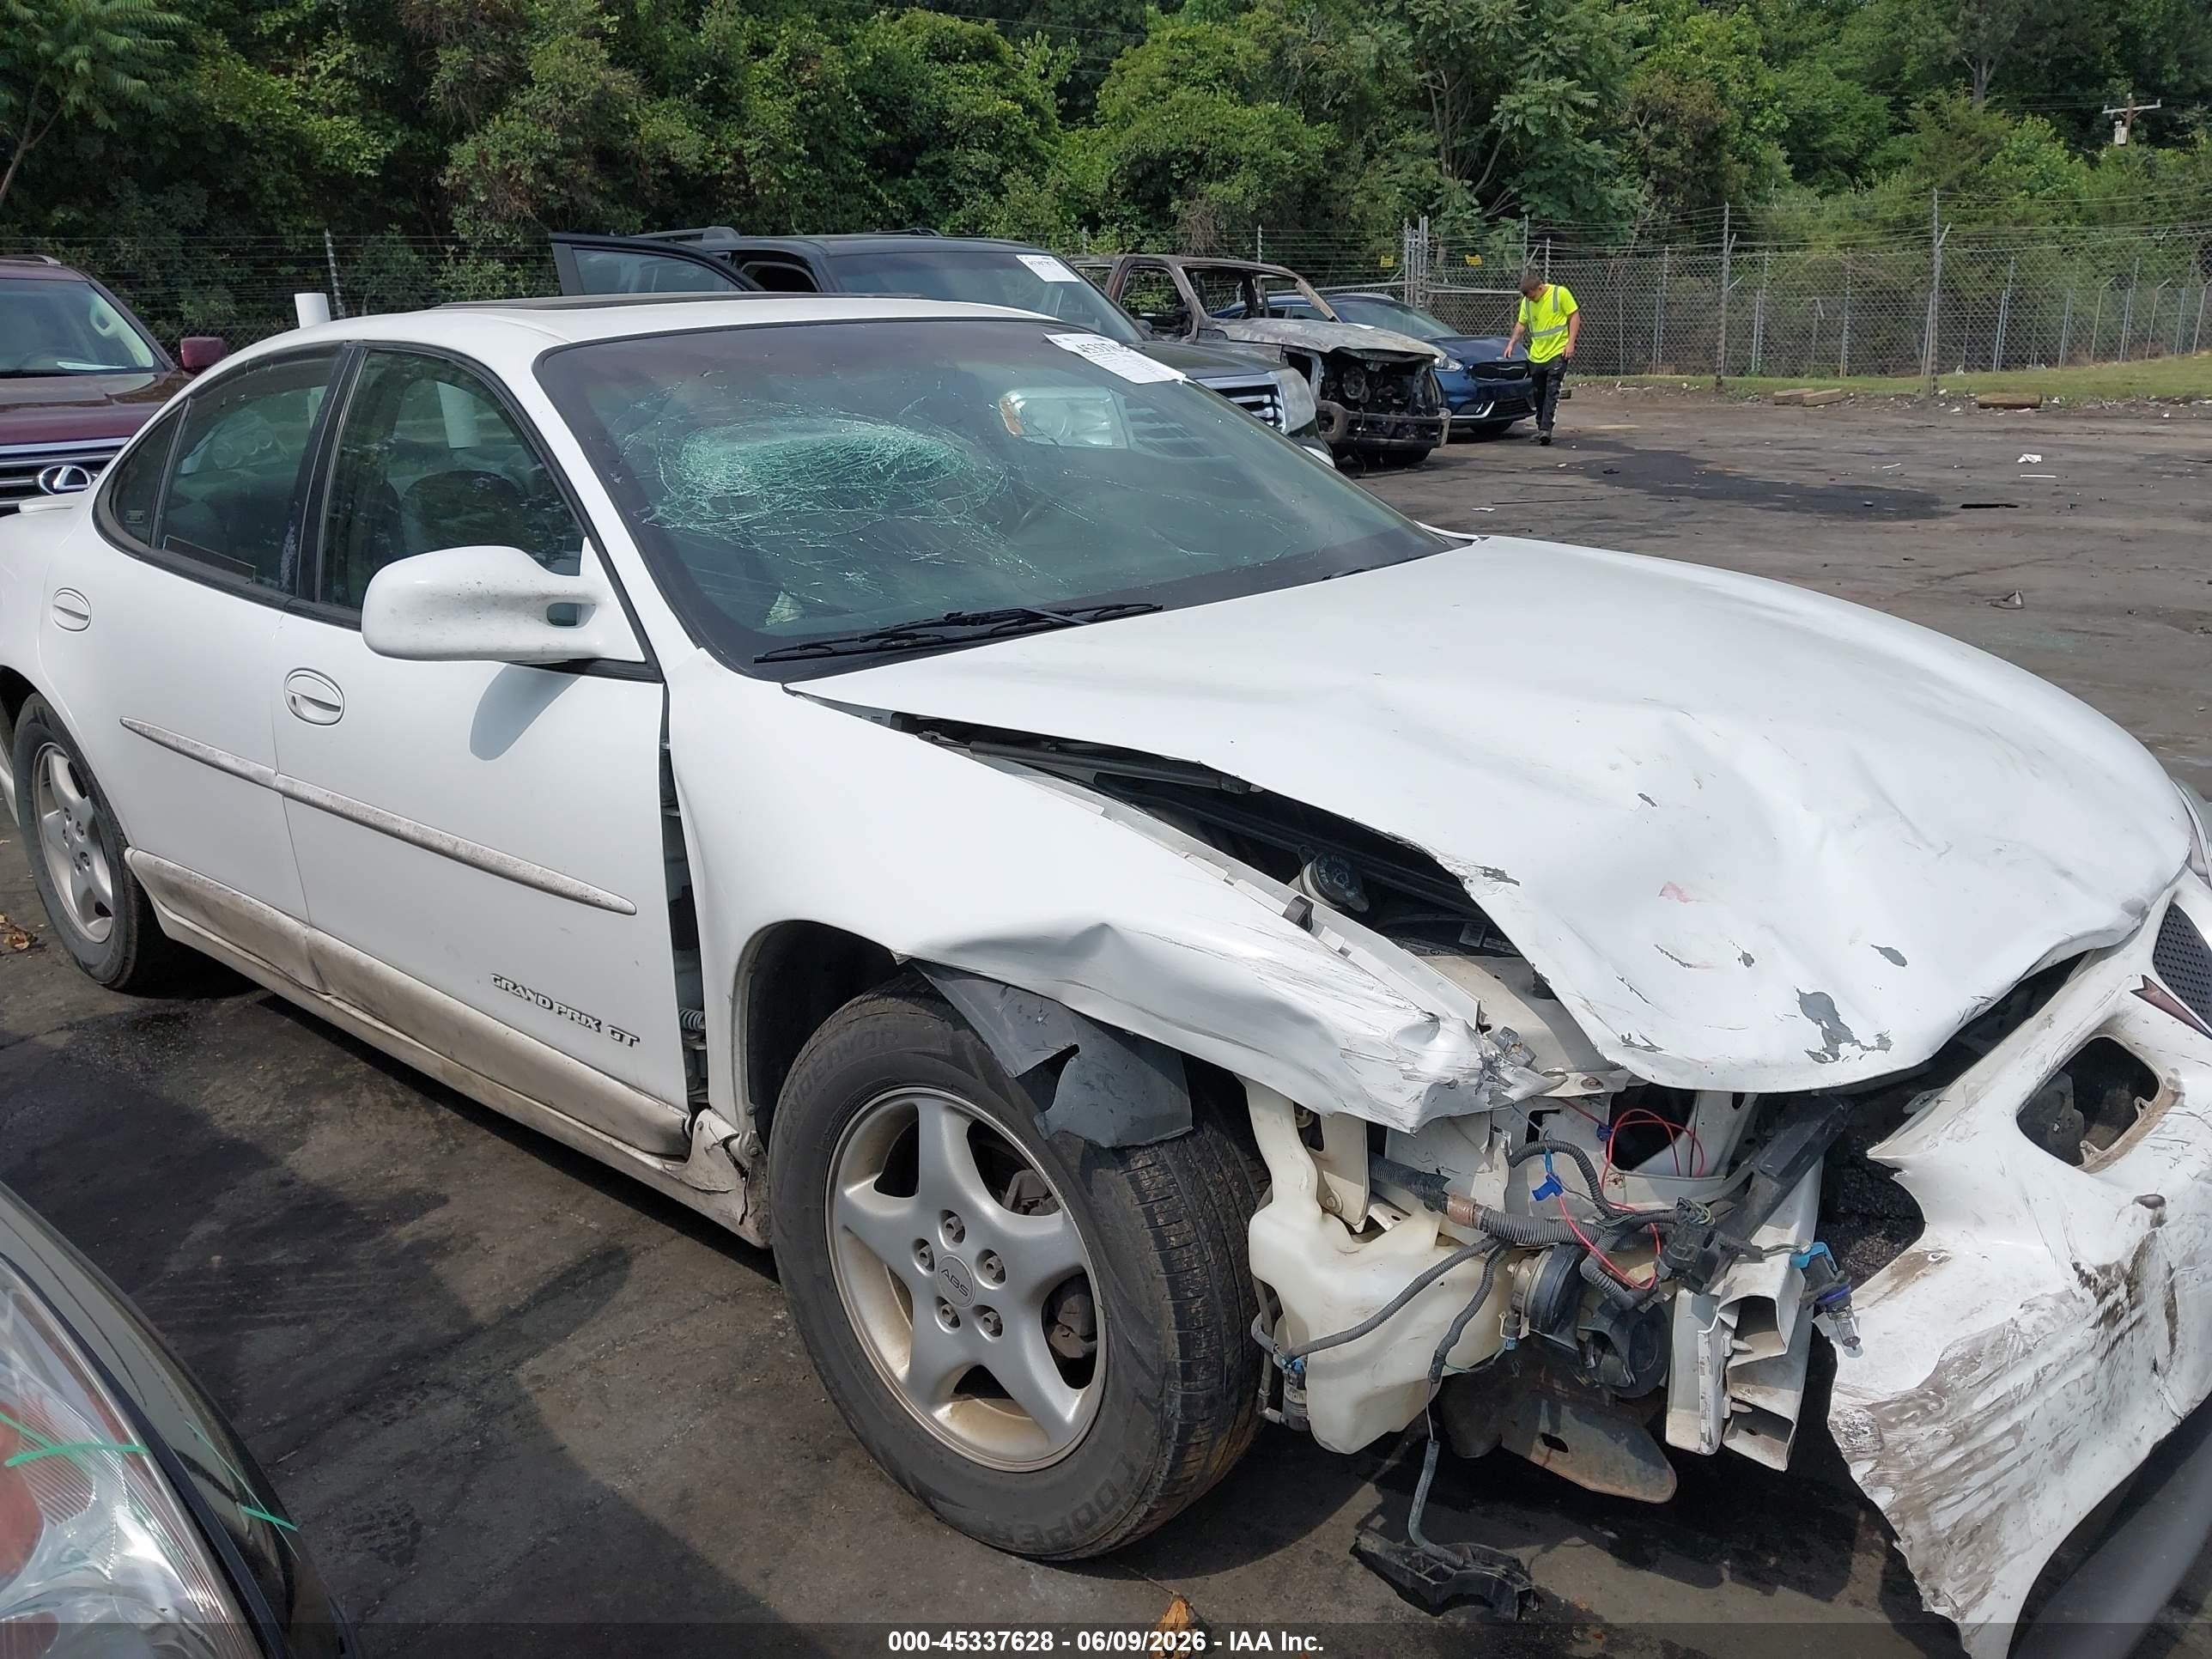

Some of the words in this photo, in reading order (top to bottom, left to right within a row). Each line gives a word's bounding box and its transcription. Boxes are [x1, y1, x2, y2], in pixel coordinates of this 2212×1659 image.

[489, 973, 554, 1011] GRAND
[552, 1001, 603, 1033] PRIX
[605, 1024, 641, 1048] GT
[940, 1268, 969, 1297] ABS
